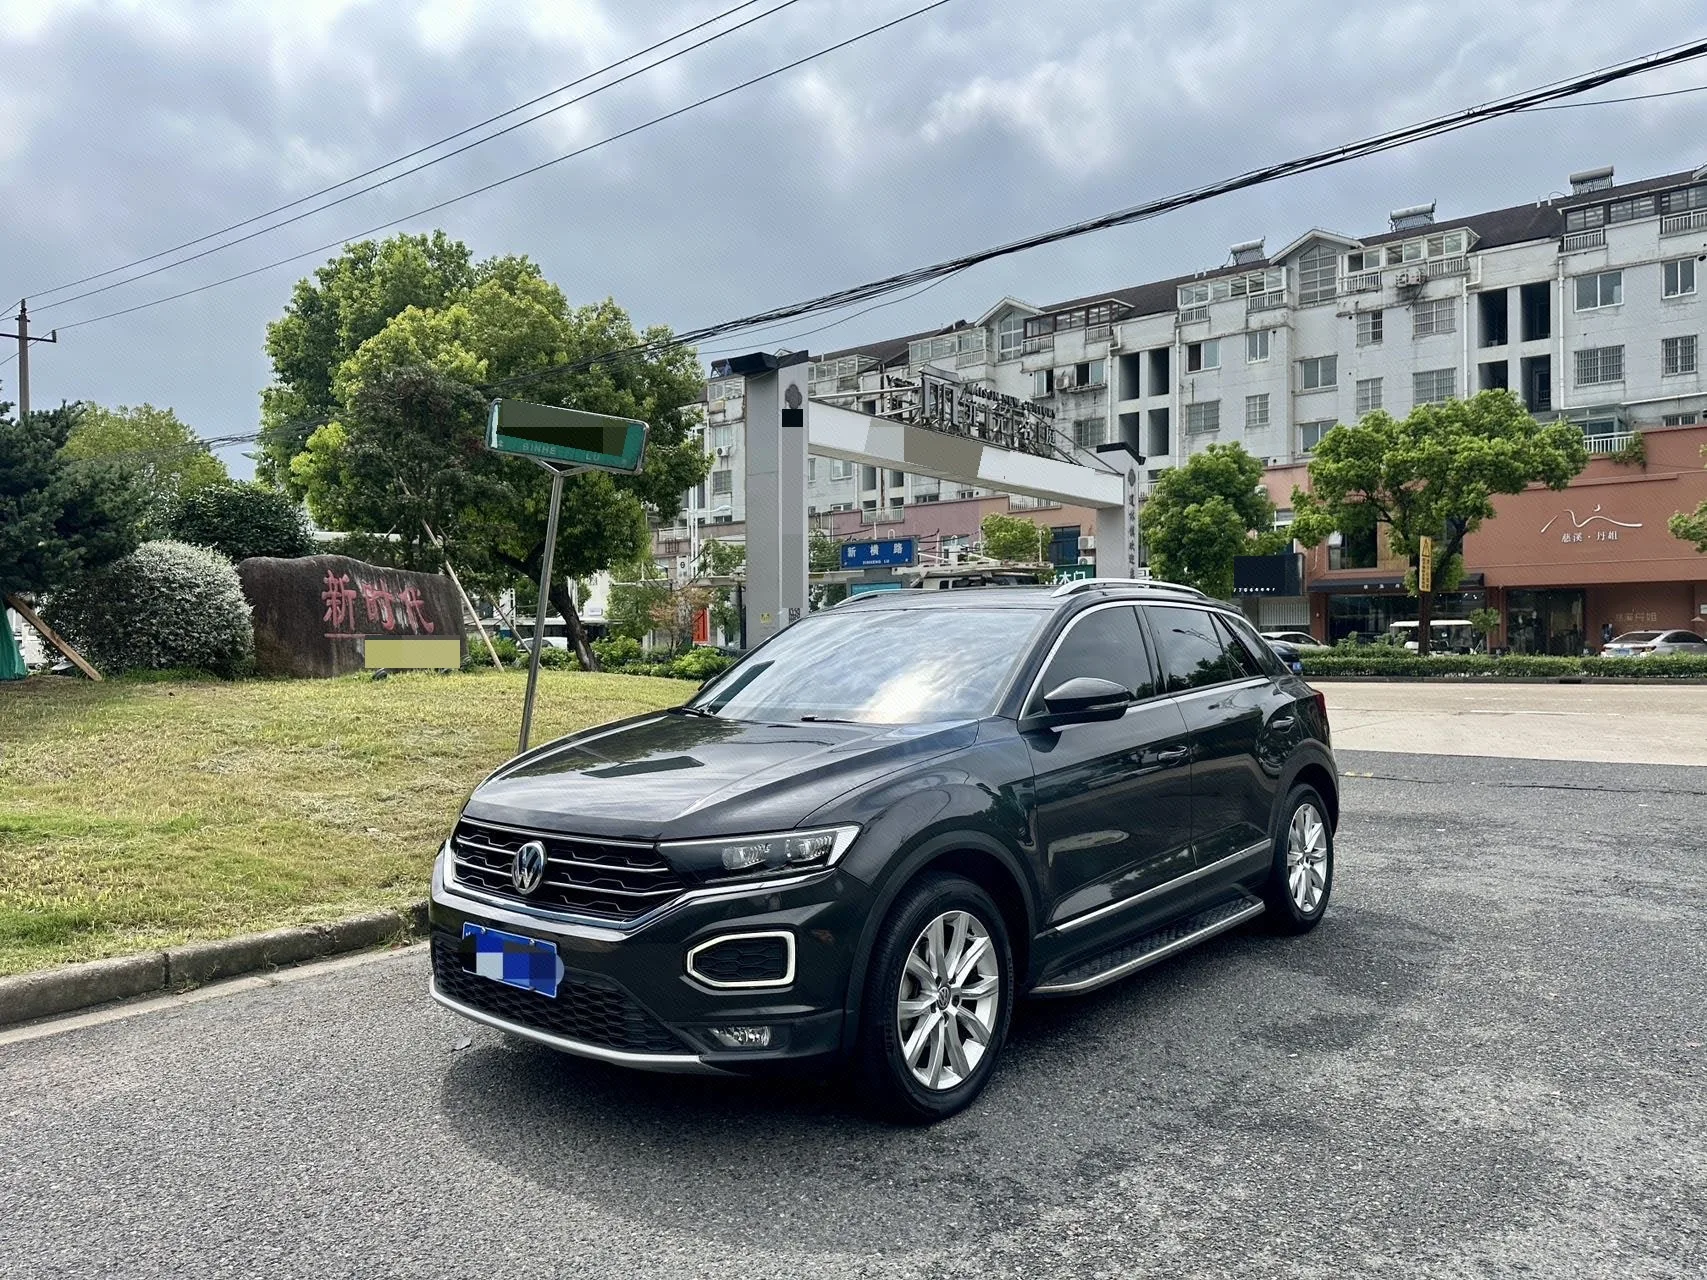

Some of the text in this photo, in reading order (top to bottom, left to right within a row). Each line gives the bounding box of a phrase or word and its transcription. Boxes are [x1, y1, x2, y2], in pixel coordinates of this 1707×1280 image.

[847, 542, 903, 558] 新横路
[321, 569, 435, 634] 新时代
